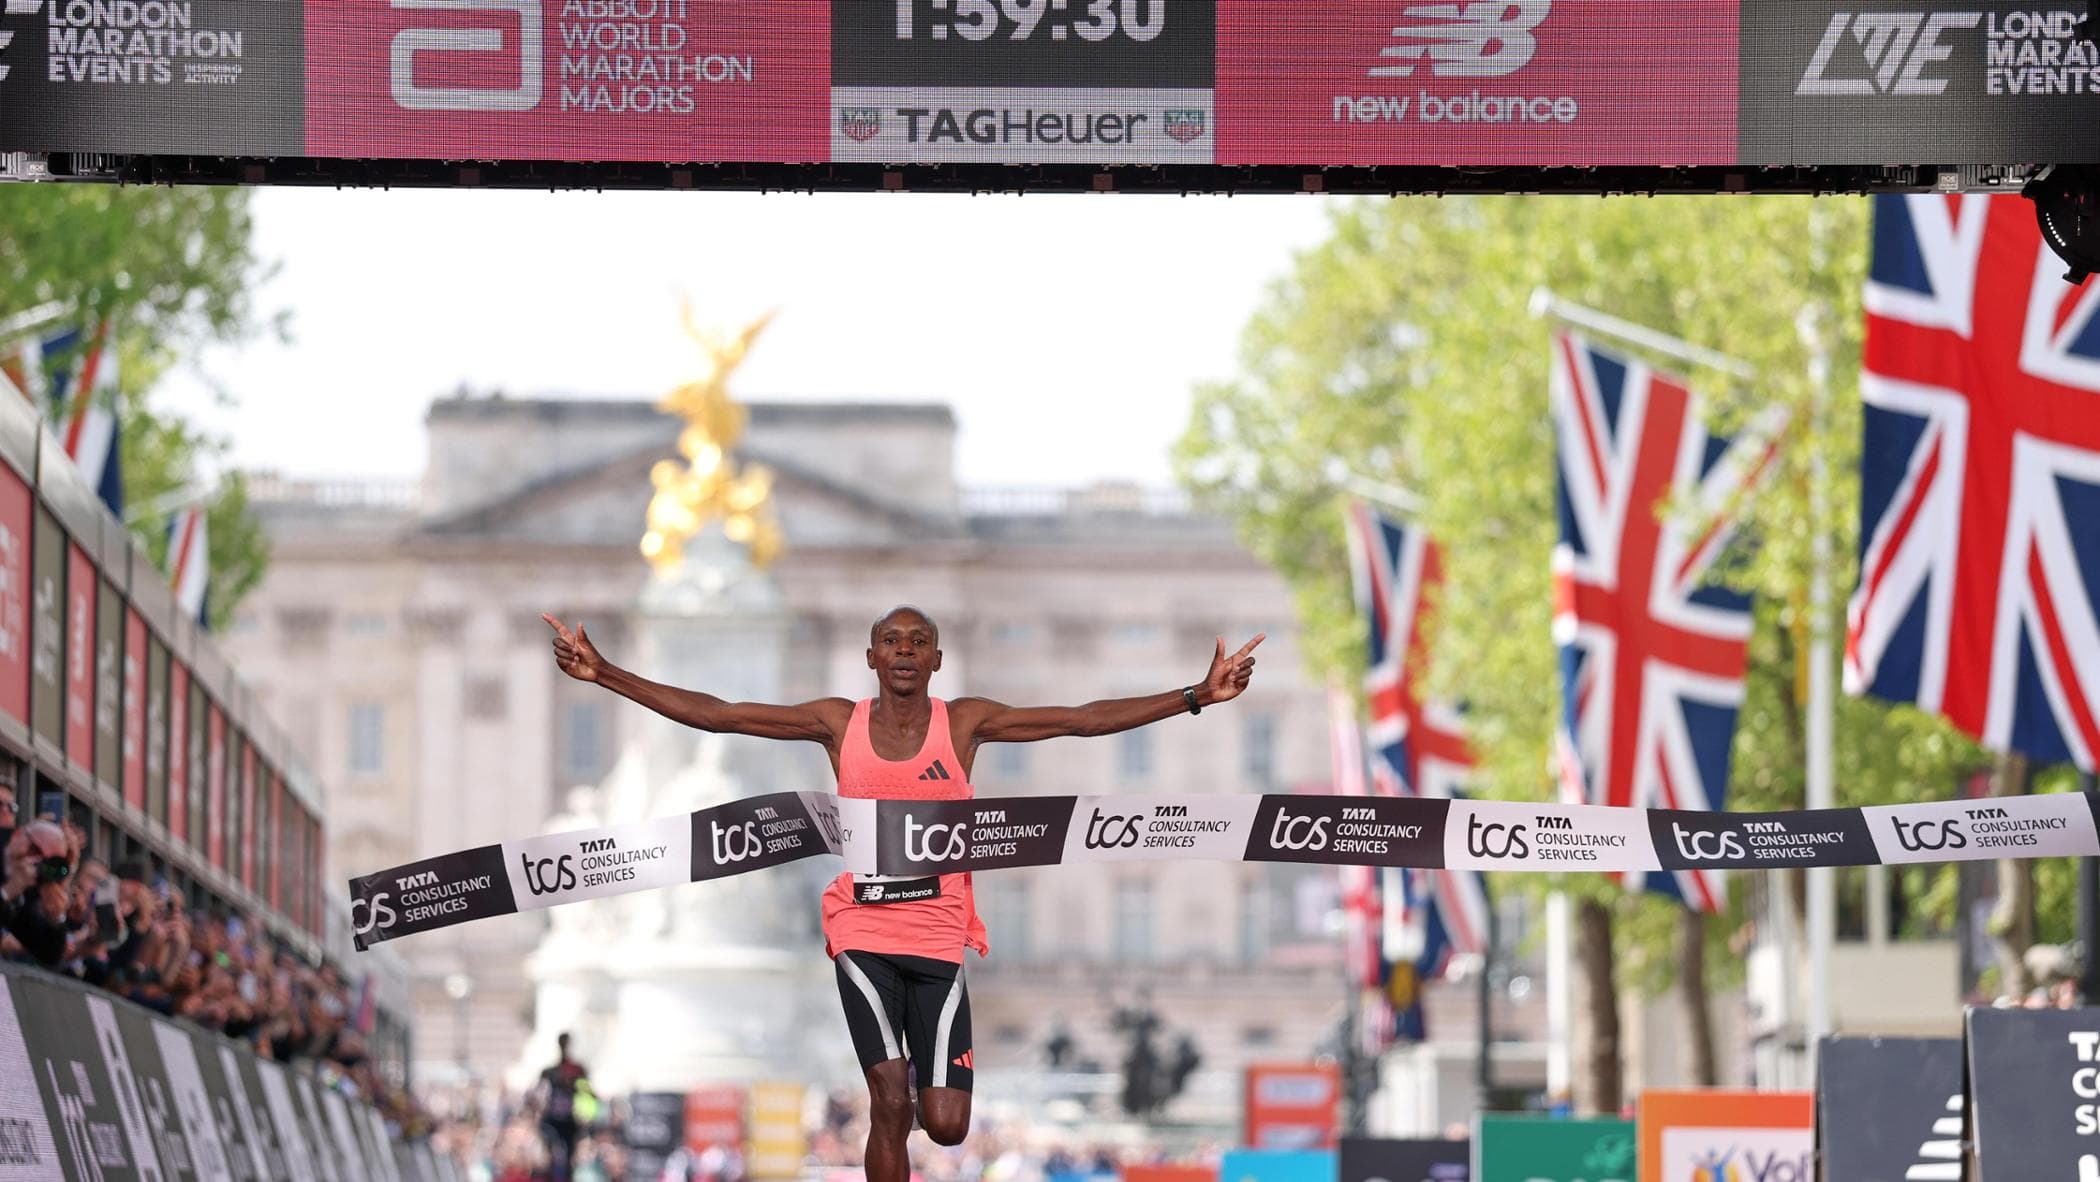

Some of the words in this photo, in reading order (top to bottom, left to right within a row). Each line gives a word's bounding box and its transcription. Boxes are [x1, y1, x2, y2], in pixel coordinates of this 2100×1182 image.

[48, 0, 191, 28] LONDON
[561, 0, 689, 18] ABBOTT
[896, 0, 1165, 41] 1:59:30
[1987, 11, 2087, 38] LOND
[48, 28, 242, 57] MARATHON
[560, 22, 688, 50] WORLD
[48, 55, 171, 83] EVENTS
[560, 54, 754, 81] MARATHON
[560, 85, 696, 112] MAJORS
[1334, 96, 1410, 122] new
[1419, 88, 1579, 123] balance
[754, 806, 778, 821] TATA
[974, 810, 1006, 824] TATA
[1155, 806, 1187, 817] TATA
[1342, 808, 1376, 820] TATA
[1965, 808, 2009, 820] TATA
[761, 818, 808, 837] CONSULTANCY
[1085, 807, 1144, 849] tcs
[1148, 820, 1231, 832] CONSULTANCY
[1270, 807, 1332, 850] tcs
[1336, 823, 1422, 838] CONSULTANCY
[1536, 816, 1572, 829] TATA
[1743, 822, 1786, 833] TATA
[1971, 818, 2067, 834] CONSULTANCY
[905, 814, 967, 862] tcs
[972, 824, 1048, 841] CONSULTANCY
[1143, 836, 1196, 847] SERVICES
[1468, 813, 1529, 859] tcs
[1535, 832, 1626, 847] CONSULTANCY
[1672, 822, 1746, 860] tcs
[1748, 832, 1844, 847] CONSULTANCY
[1891, 815, 1967, 851] tcs
[1975, 834, 2037, 848] SERVICES
[580, 838, 616, 853] TATA
[711, 820, 762, 865] tcs
[767, 834, 802, 853] SERVICES
[970, 842, 1017, 858] SERVICES
[1333, 839, 1388, 853] SERVICES
[581, 846, 667, 870] CONSULTANCY
[1538, 849, 1597, 860] SERVICES
[1754, 847, 1816, 859] SERVICES
[396, 871, 439, 891] TATA
[522, 852, 576, 896] tcs
[584, 867, 635, 887] SERVICES
[400, 875, 491, 906] CONSULTANCY
[902, 888, 933, 899] balance
[350, 892, 397, 935] cs
[405, 897, 468, 923] SERVICES
